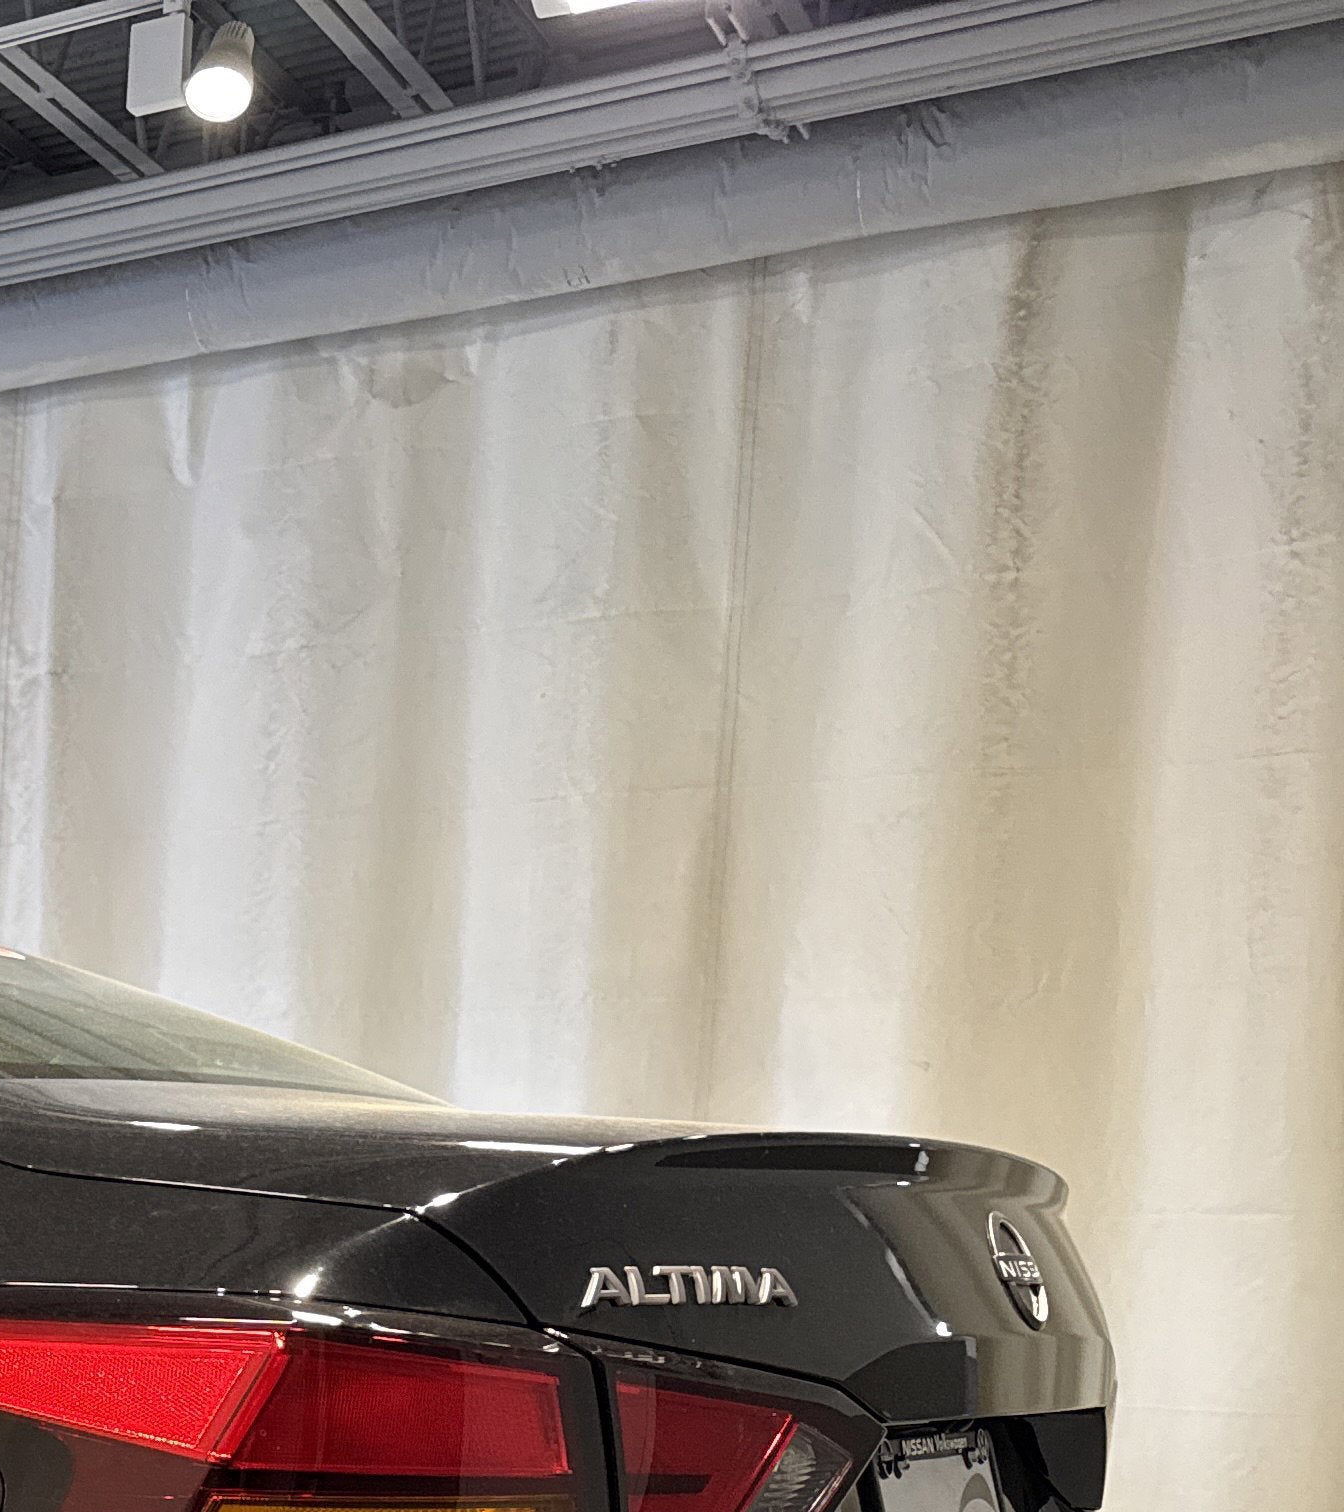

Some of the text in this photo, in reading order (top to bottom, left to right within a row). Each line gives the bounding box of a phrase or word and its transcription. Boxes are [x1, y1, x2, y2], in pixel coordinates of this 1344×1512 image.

[998, 1258, 1040, 1280] NISS
[580, 1265, 799, 1308] ALTIMA
[901, 1437, 935, 1456] NISSAN
